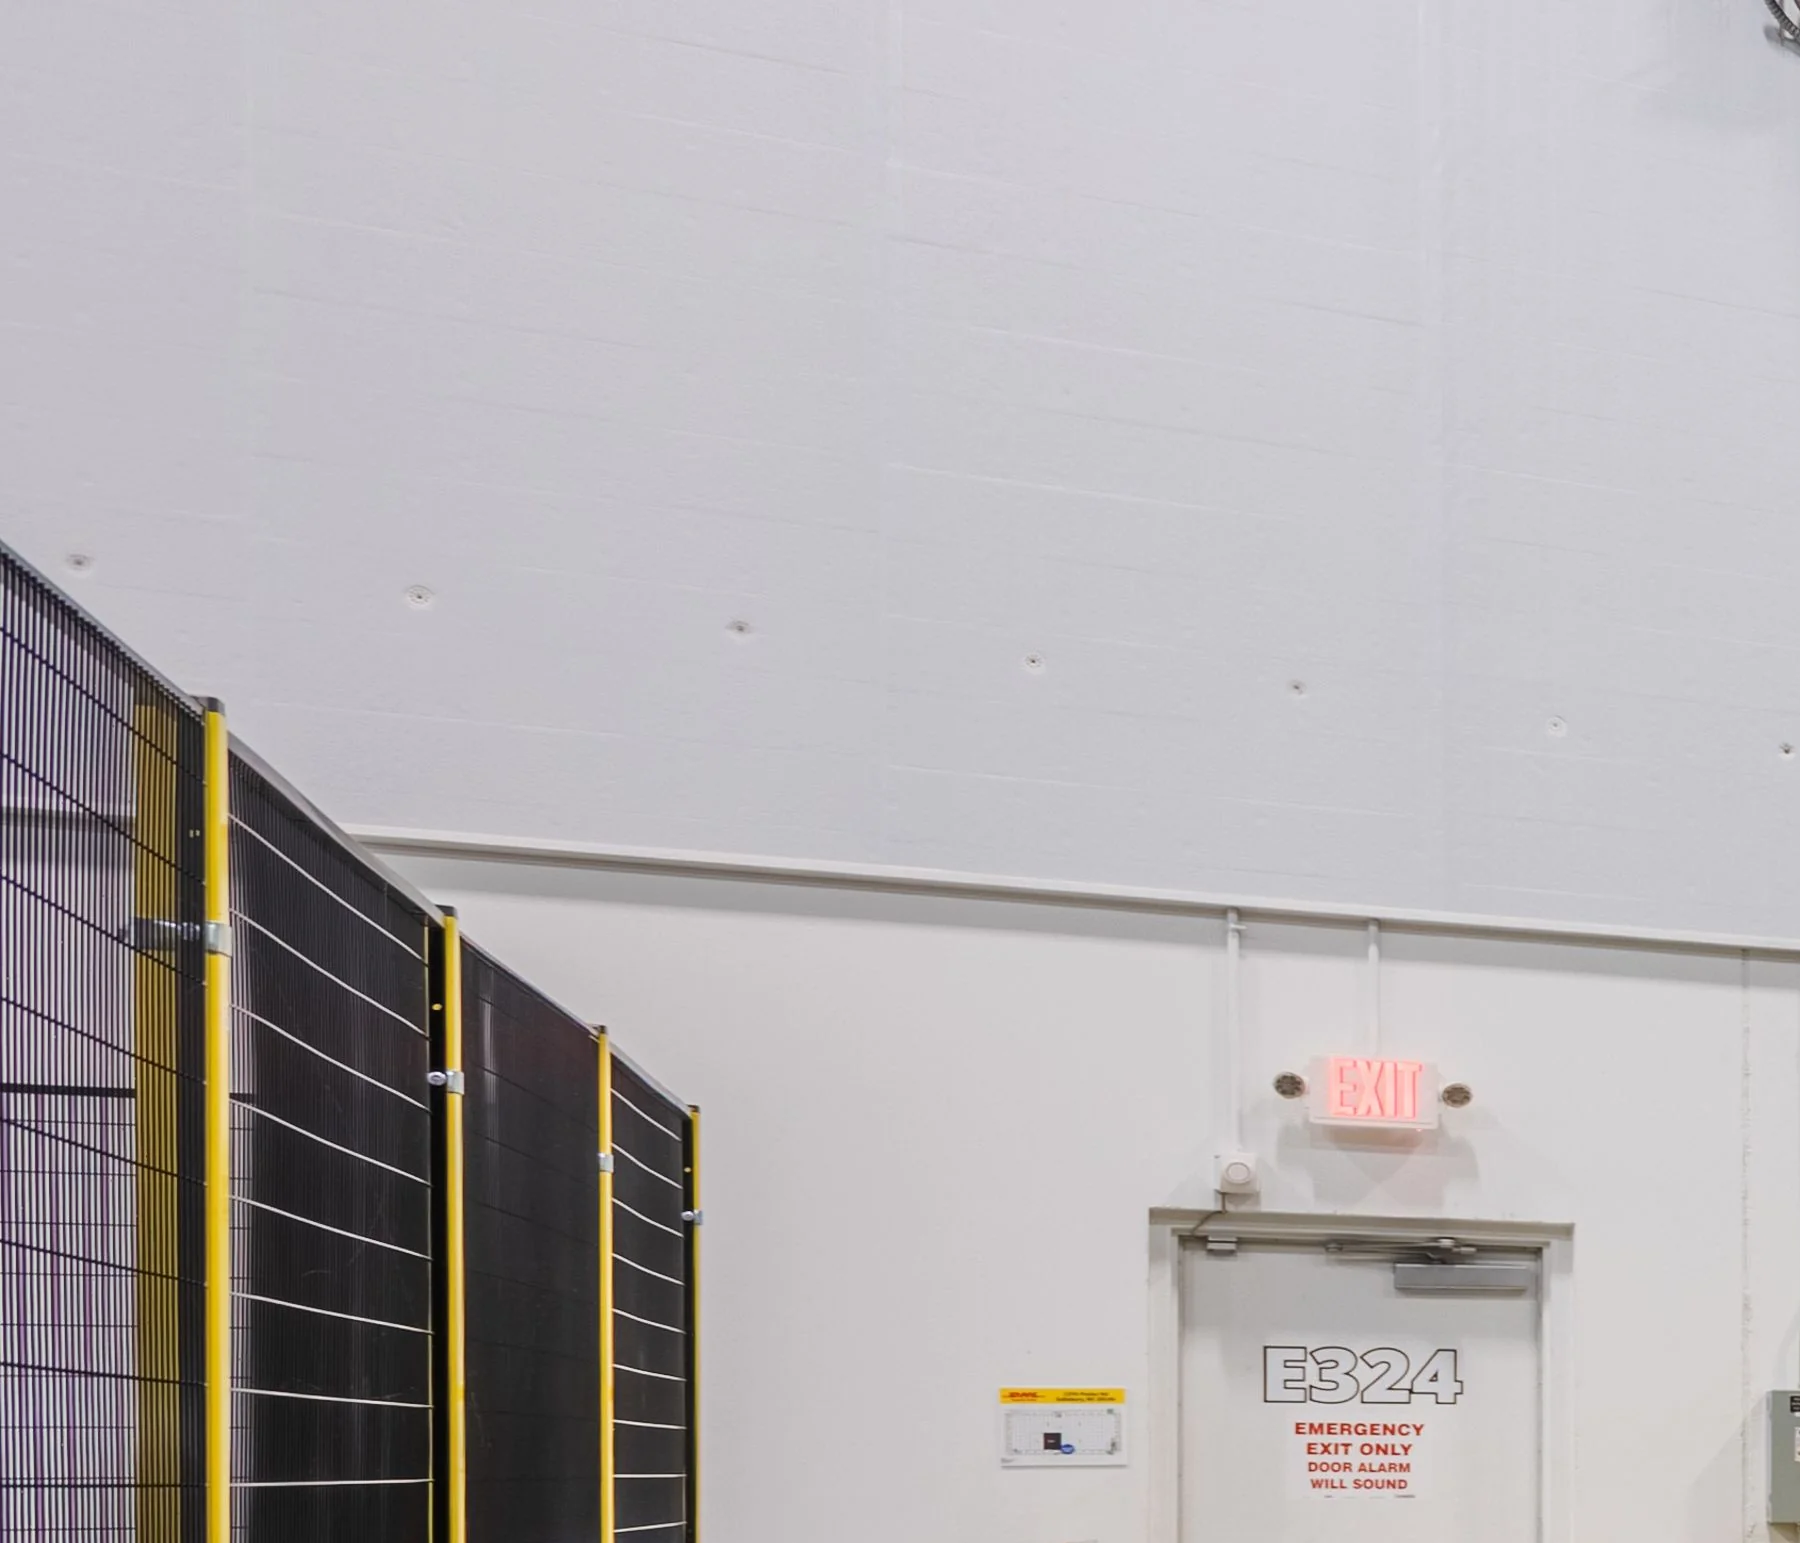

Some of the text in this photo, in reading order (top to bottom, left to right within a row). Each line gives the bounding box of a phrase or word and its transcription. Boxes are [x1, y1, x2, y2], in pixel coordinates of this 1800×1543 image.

[1330, 1056, 1422, 1120] EXIT
[1263, 1346, 1463, 1404] E324
[1295, 1423, 1425, 1436] EMERGENCY
[1306, 1443, 1413, 1456] EXIT ONLY
[1308, 1462, 1410, 1473] DOOR ALARM
[1311, 1479, 1408, 1490] WILL SOUND
